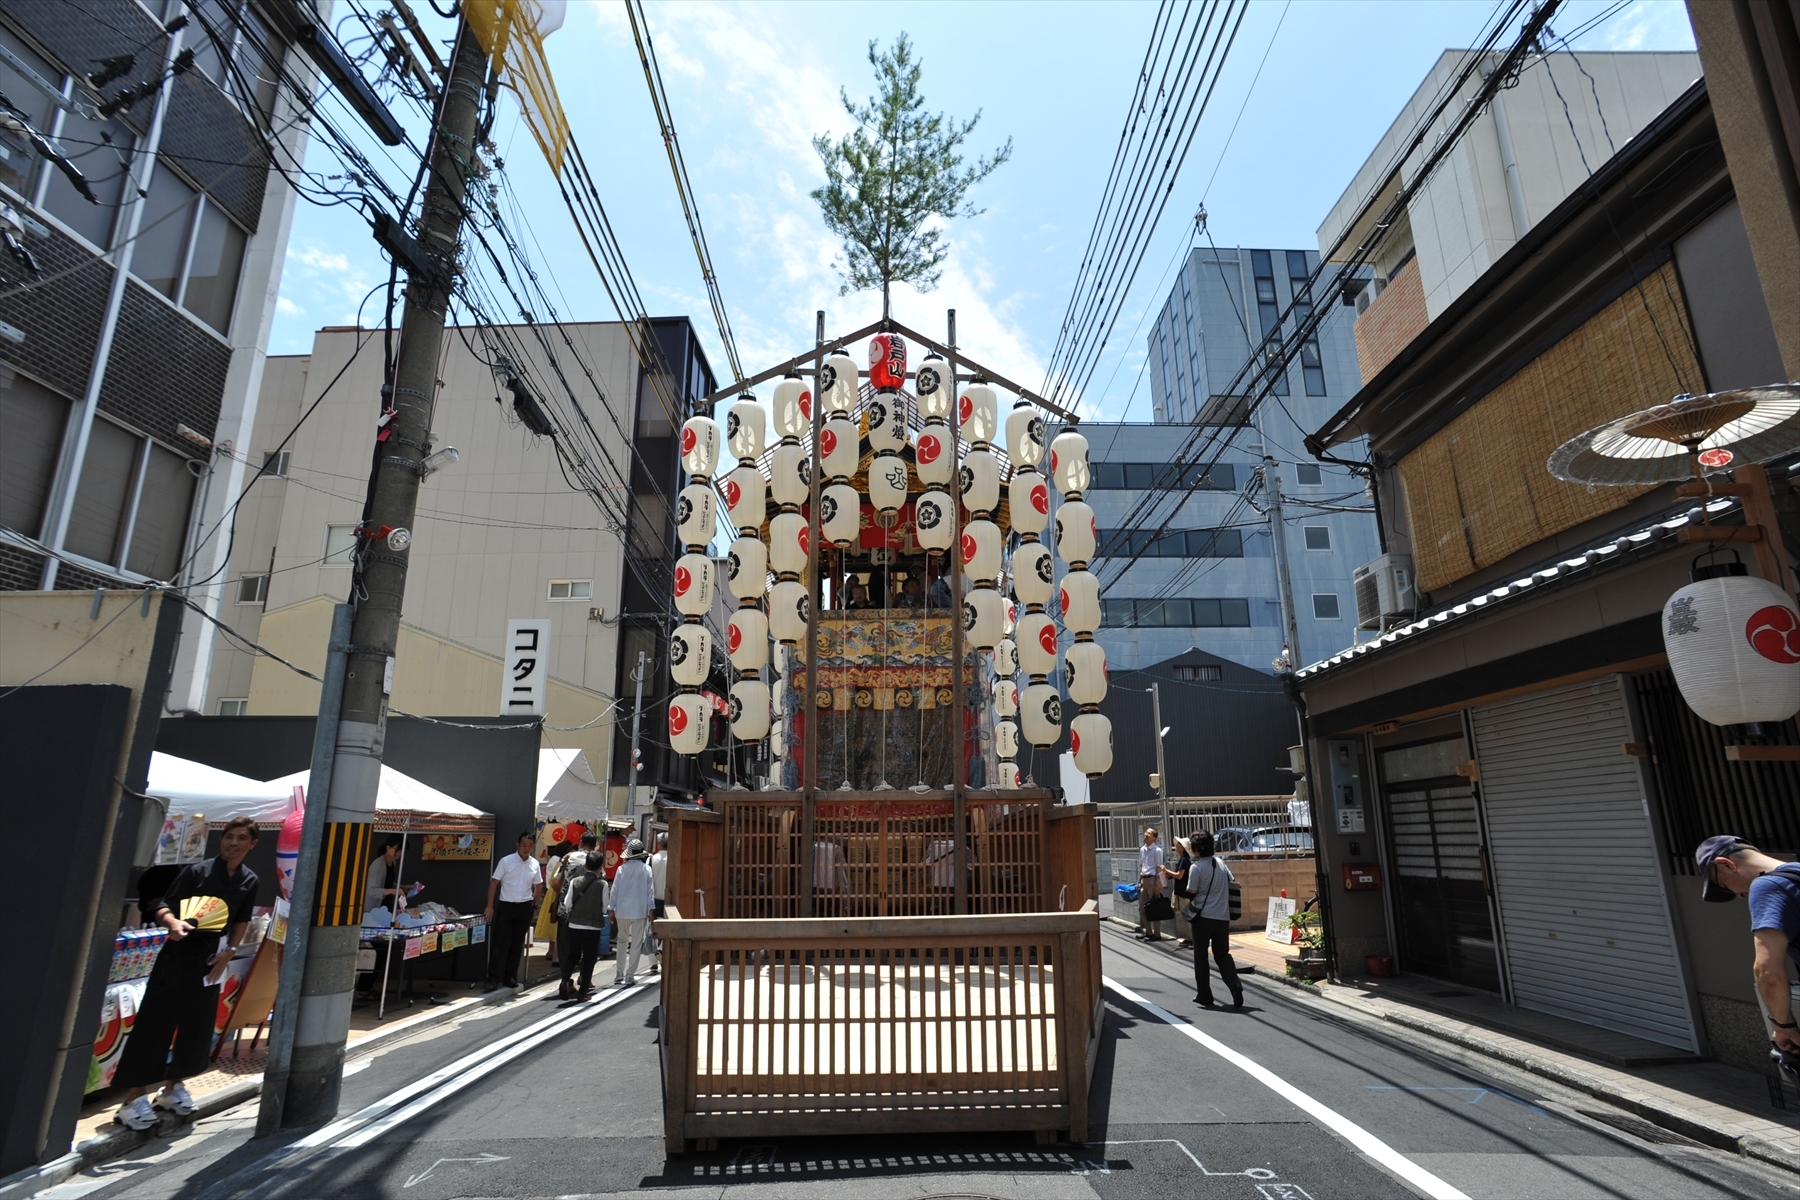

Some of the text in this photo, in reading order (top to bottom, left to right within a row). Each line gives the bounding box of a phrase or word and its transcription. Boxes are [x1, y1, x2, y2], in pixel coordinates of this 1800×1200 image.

[889, 335, 905, 378] 岩戸山
[508, 629, 539, 706] コタニ
[121, 986, 130, 1013] メロン
